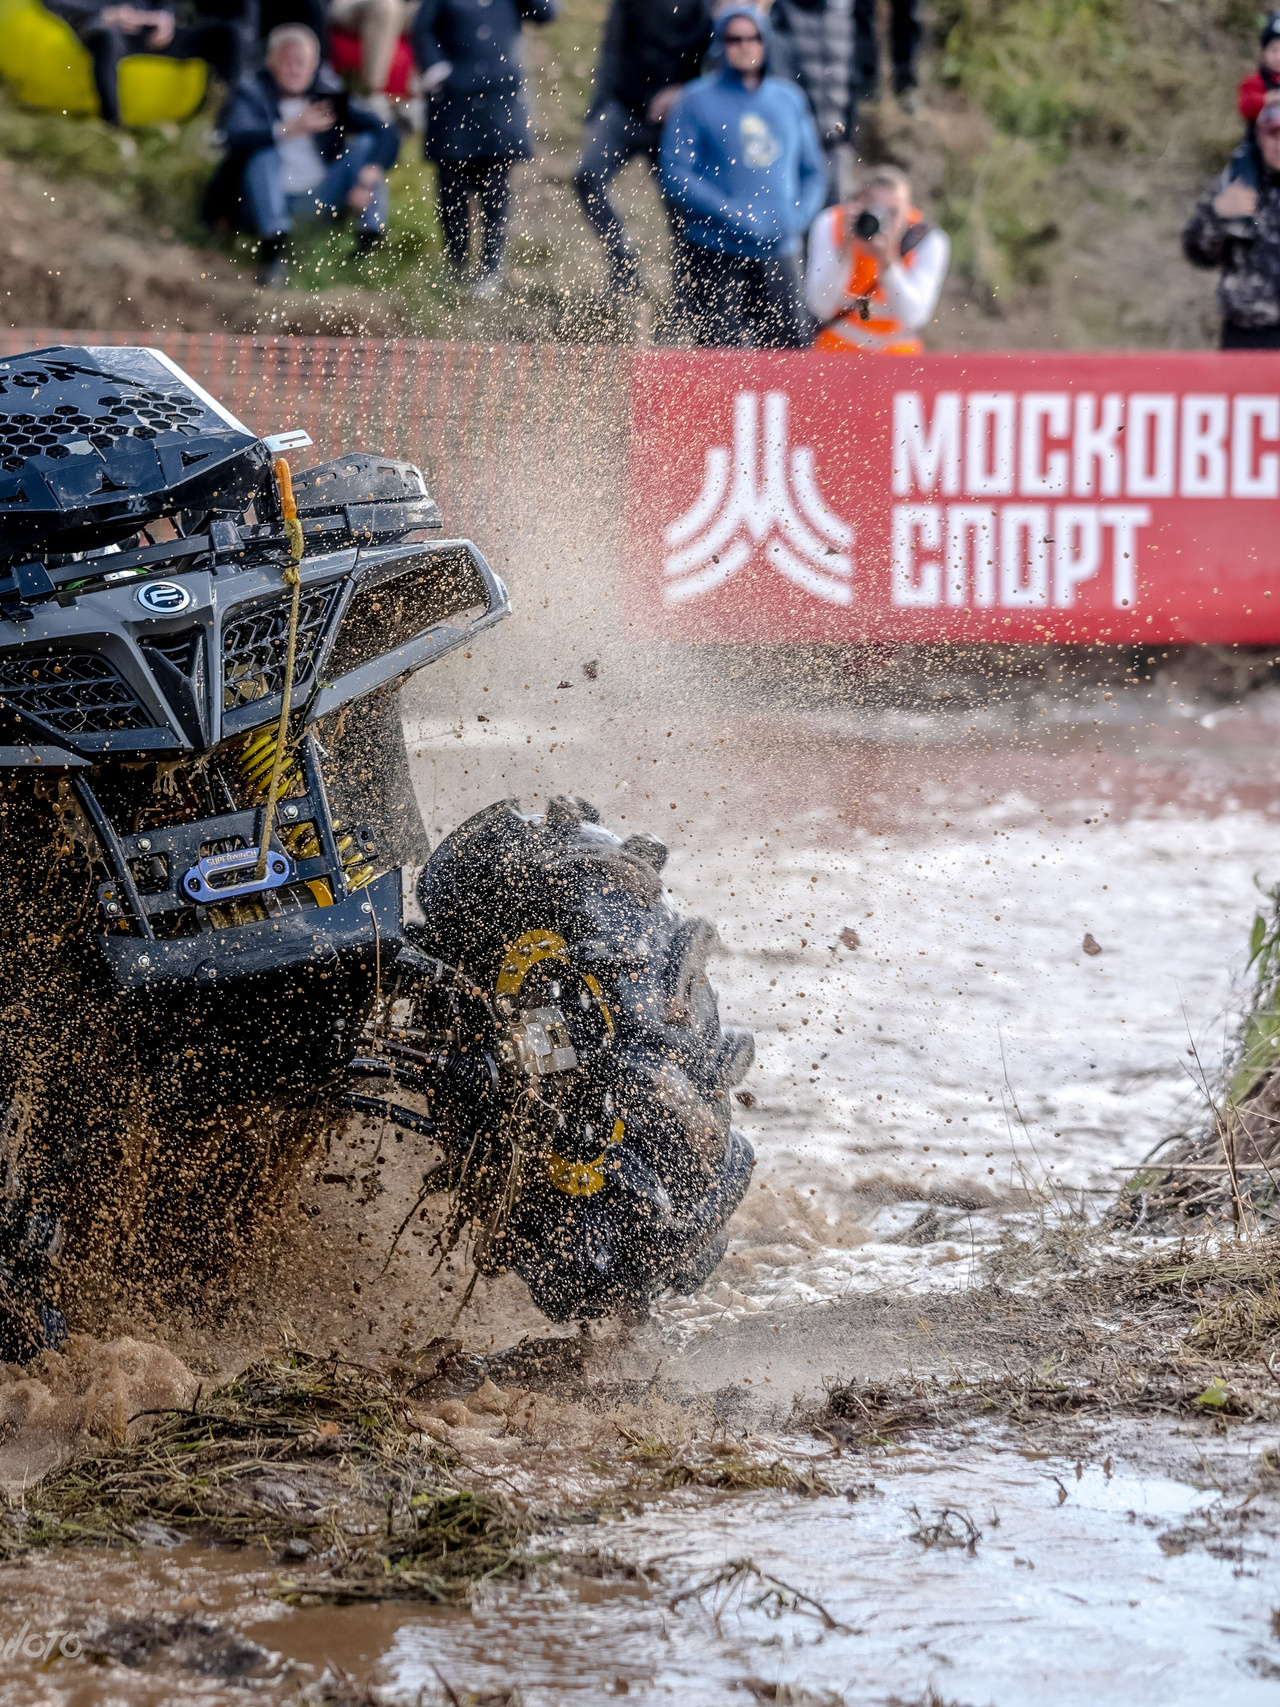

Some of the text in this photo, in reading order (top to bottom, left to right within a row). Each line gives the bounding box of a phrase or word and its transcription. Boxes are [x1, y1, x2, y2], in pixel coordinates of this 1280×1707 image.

[892, 391, 1280, 498] МОСКОВС
[892, 503, 1151, 609] СПОРТ
[205, 849, 258, 866] SUPERWINCH
